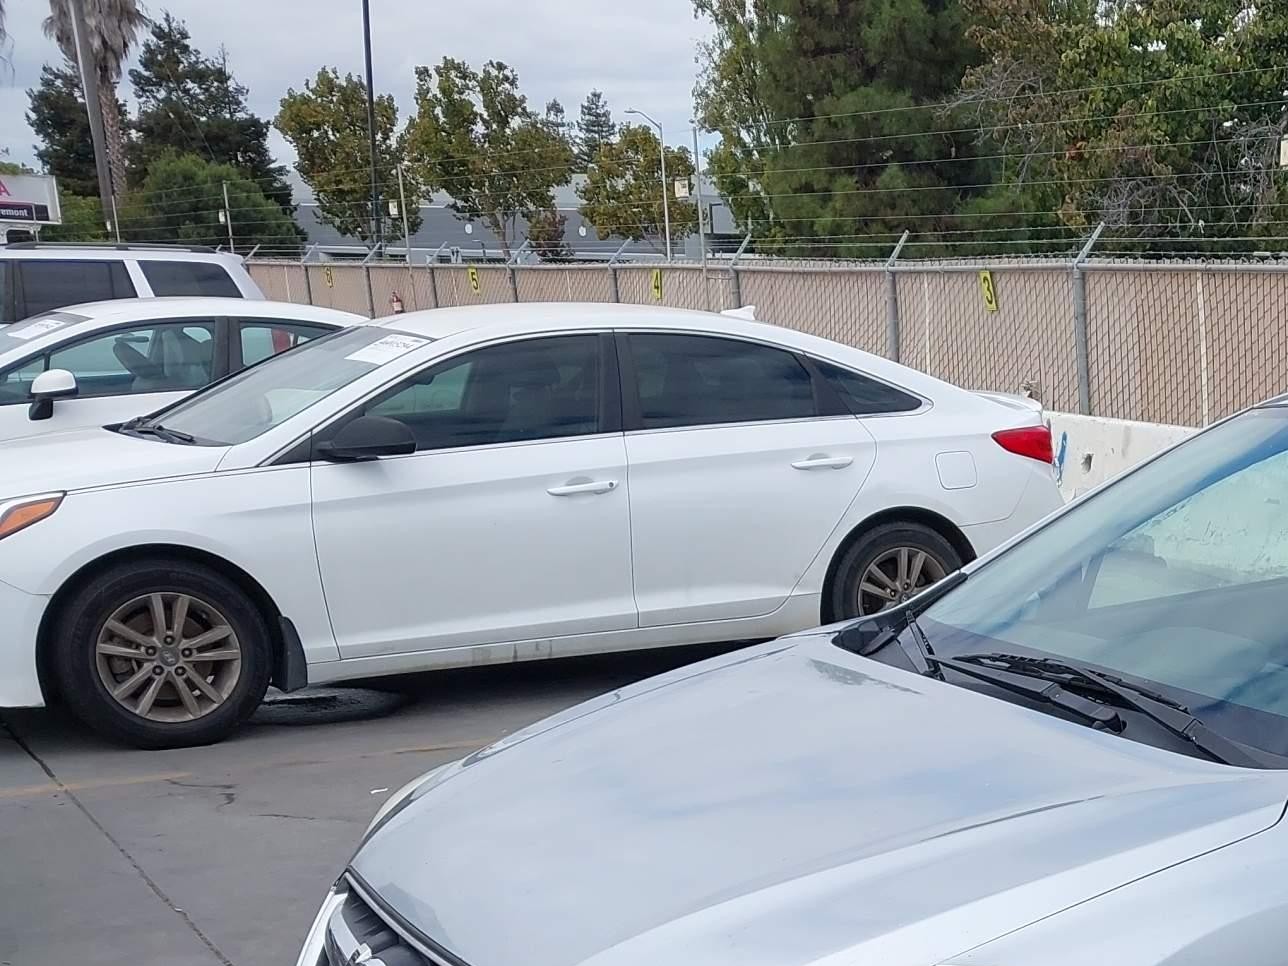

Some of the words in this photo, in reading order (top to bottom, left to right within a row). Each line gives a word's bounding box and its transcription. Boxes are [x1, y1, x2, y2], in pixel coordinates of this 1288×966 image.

[470, 271, 479, 290] 5
[653, 271, 660, 294] 4
[982, 275, 993, 305] 3
